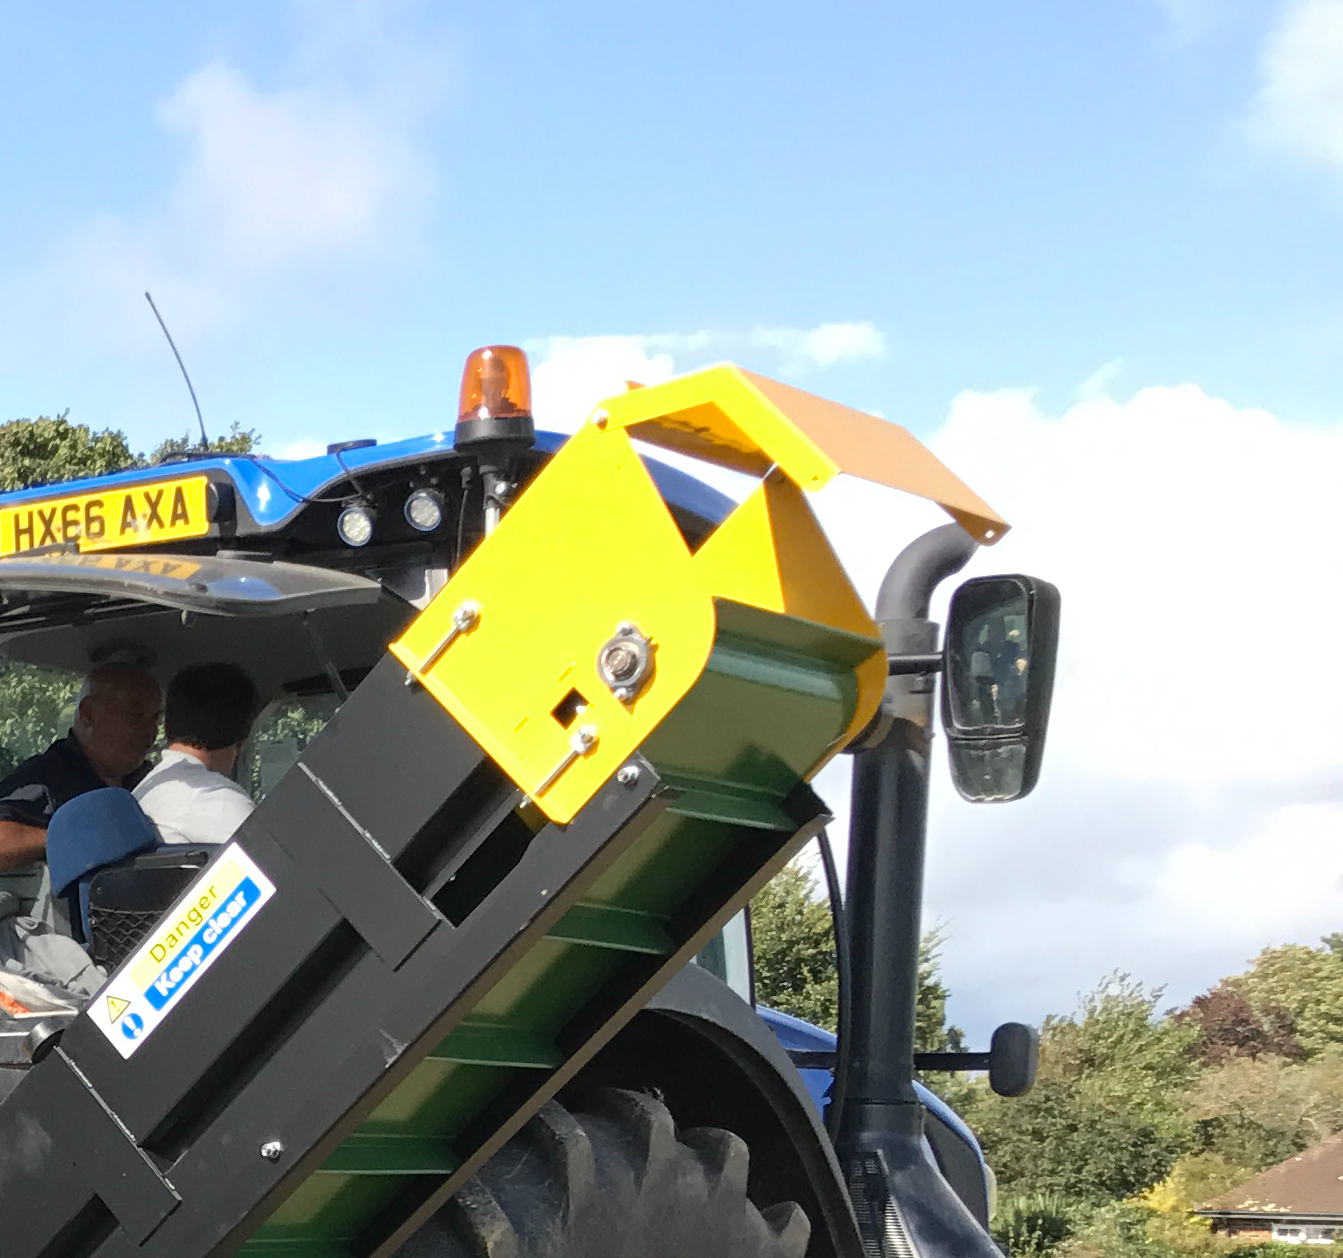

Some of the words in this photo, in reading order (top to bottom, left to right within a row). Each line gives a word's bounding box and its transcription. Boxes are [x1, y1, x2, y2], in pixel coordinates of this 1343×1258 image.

[14, 499, 106, 552] HX66
[119, 486, 190, 536] AXA
[149, 884, 217, 963] Danger
[154, 943, 204, 997] Keep
[202, 890, 248, 945] clear
